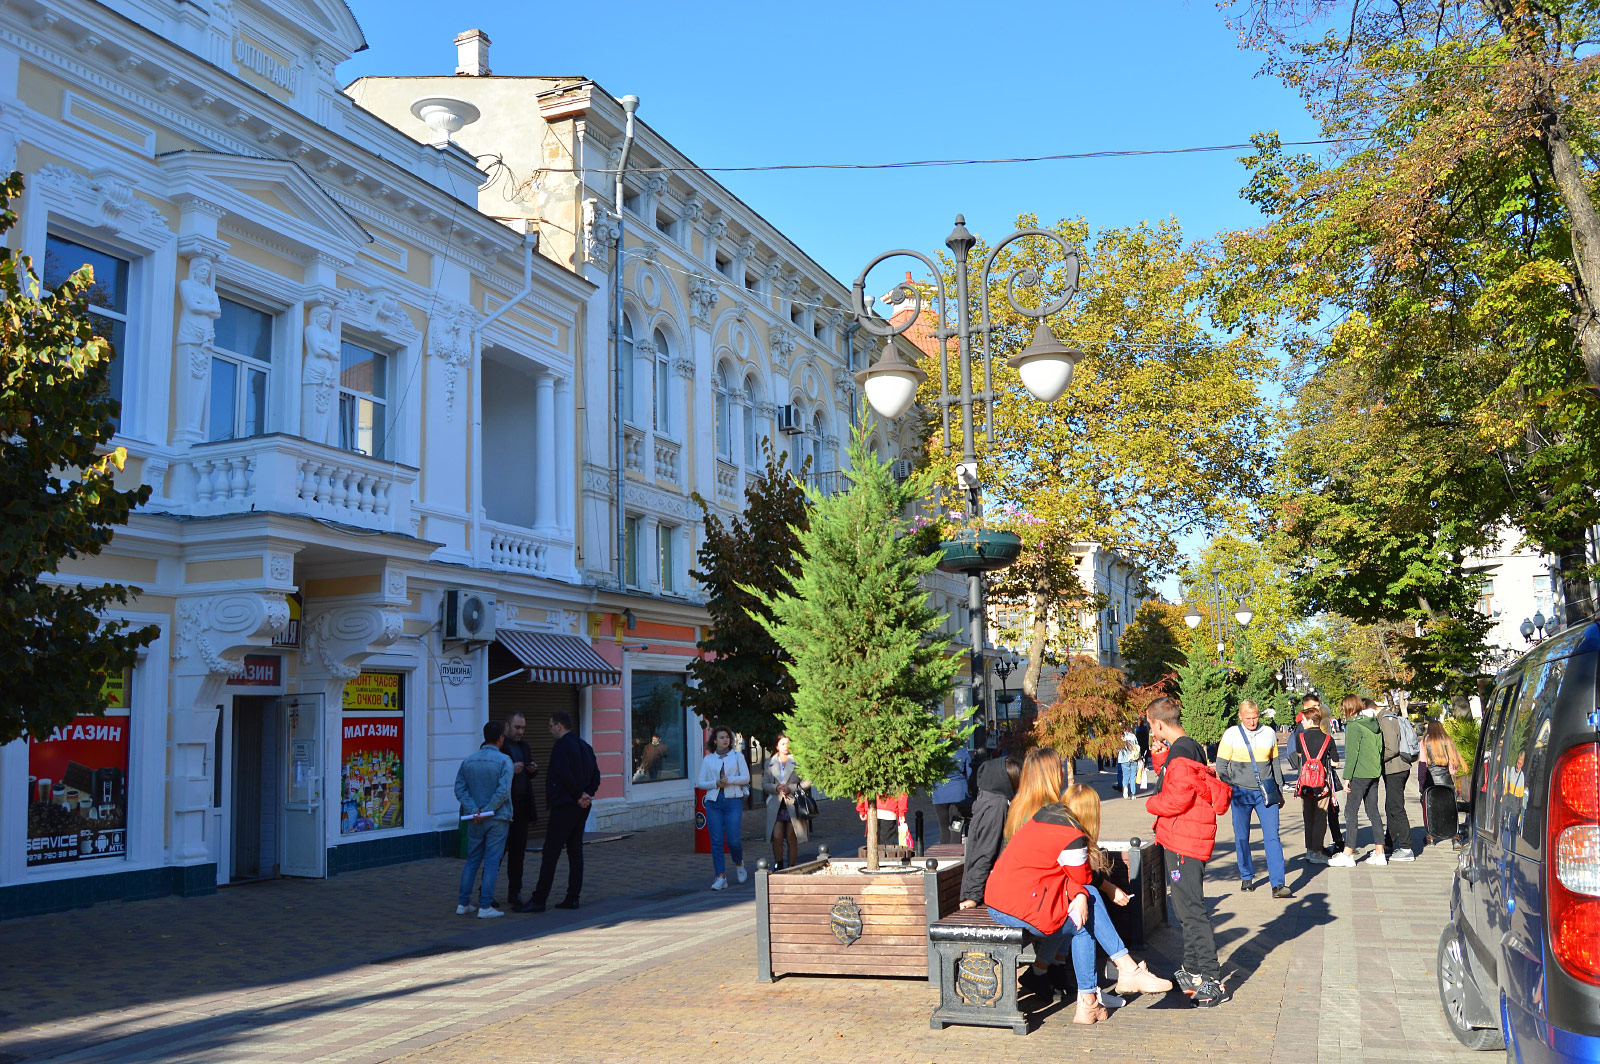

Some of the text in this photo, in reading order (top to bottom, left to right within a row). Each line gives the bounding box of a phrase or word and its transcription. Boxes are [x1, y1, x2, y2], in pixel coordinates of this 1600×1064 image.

[442, 666, 471, 675] ПУШКИНА
[374, 675, 398, 688] ЧАСОВ
[356, 693, 382, 705] ОЧКОВ
[34, 725, 121, 743] АГАЗИН
[343, 724, 399, 739] МАГАЗИН
